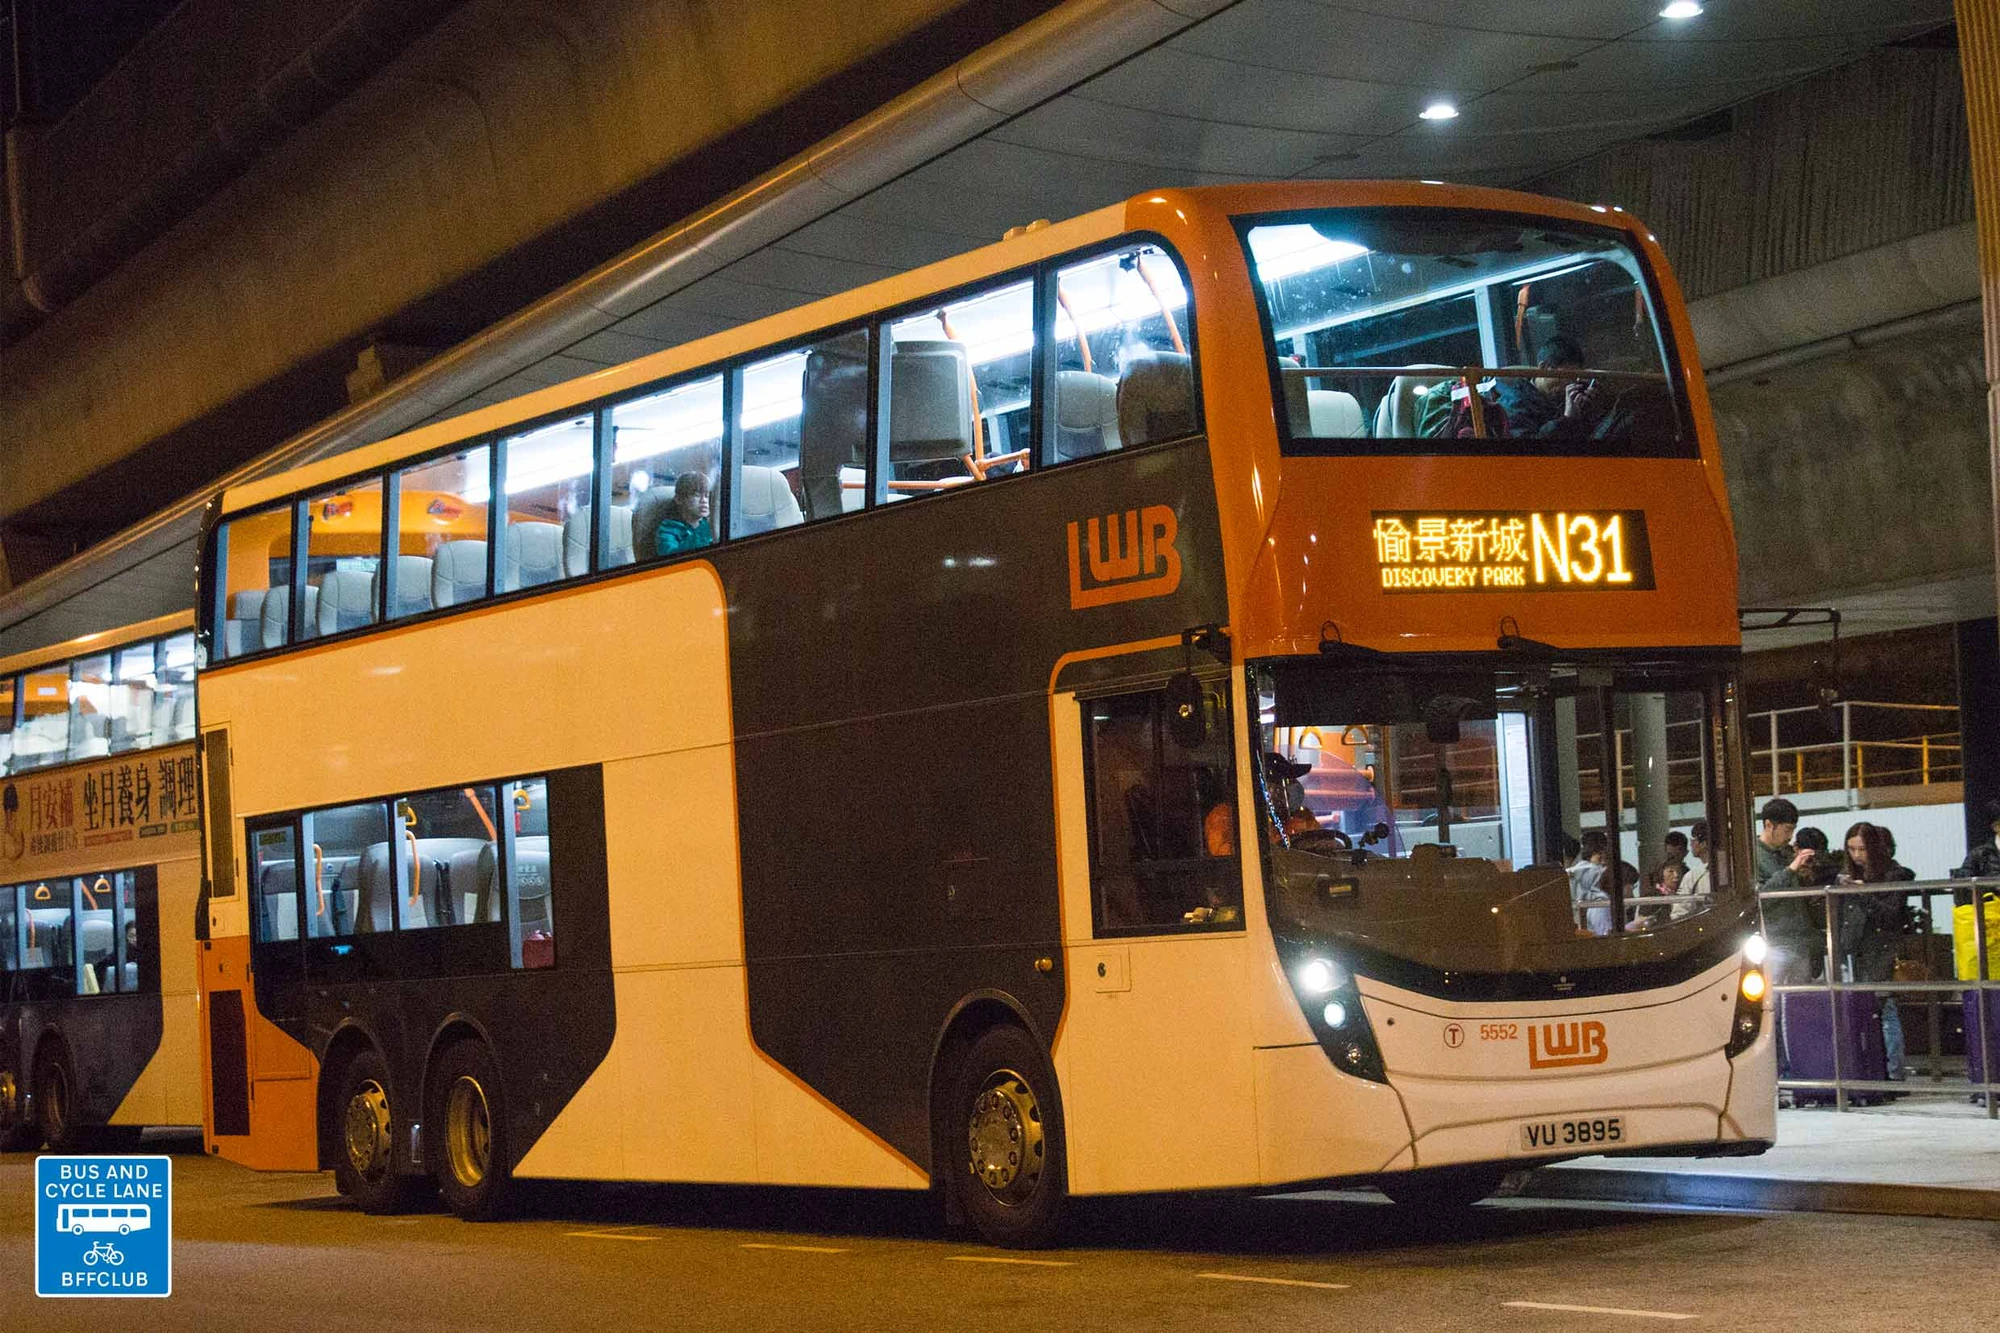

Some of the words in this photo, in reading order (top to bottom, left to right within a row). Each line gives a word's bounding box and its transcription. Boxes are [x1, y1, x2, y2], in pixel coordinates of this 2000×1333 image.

[1067, 504, 1182, 609] LWB
[1373, 518, 1529, 563] 愉景新城
[1531, 513, 1633, 583] N31
[1382, 566, 1478, 588] DISCOVERY
[1483, 566, 1526, 587] PARK
[84, 763, 150, 832] 坐月養身
[159, 755, 196, 820] 調理
[1480, 1023, 1518, 1040] 5552
[1527, 1021, 1608, 1070] LWB
[1527, 1123, 1556, 1147] VU
[1563, 1119, 1621, 1144] 3895
